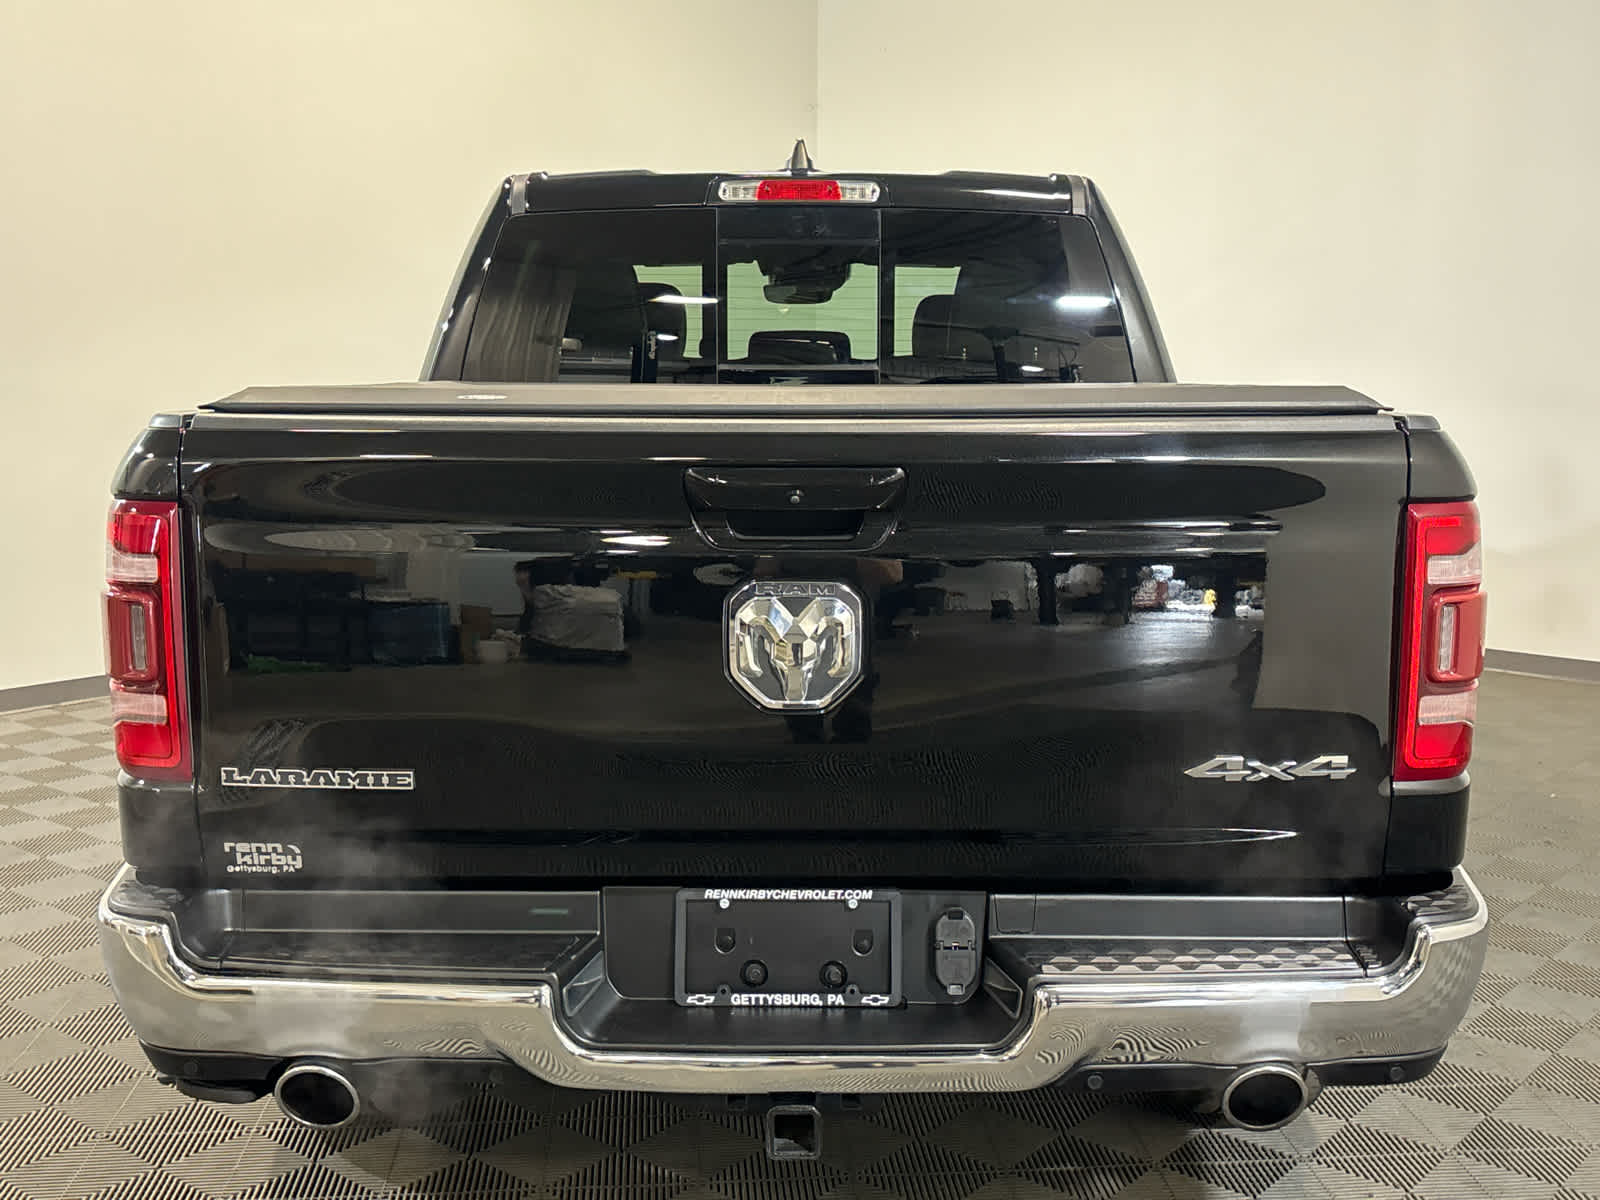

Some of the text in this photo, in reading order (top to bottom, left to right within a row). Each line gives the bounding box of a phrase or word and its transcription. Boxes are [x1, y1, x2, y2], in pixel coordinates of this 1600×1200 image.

[755, 583, 836, 596] RAM
[1184, 755, 1357, 781] 4x4
[221, 767, 414, 790] LARAMIE
[223, 842, 283, 853] renn
[235, 852, 303, 869] kirby
[283, 865, 296, 873] PA
[704, 888, 874, 900] RENNKIRBYCHEVROLET.COM
[730, 993, 846, 1007] GETTYSBURG, PA
